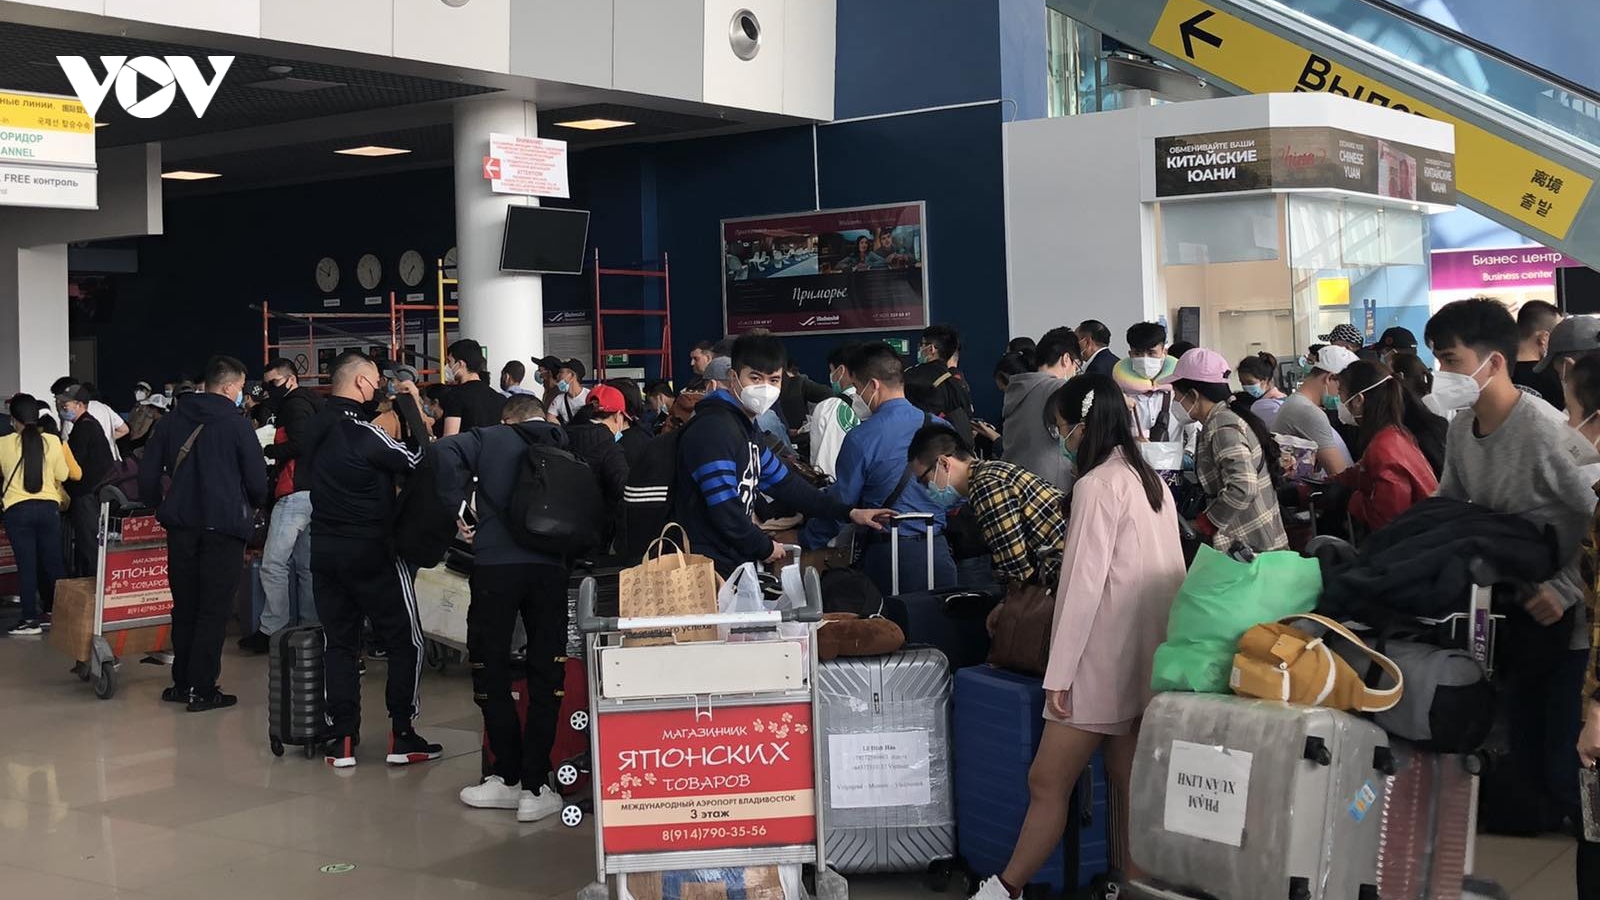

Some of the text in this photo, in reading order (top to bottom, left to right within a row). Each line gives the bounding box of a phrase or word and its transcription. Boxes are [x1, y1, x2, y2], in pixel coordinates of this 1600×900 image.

[1169, 140, 1255, 154] ОБМЕНИВАЙТЕ ВАШИ
[1166, 149, 1258, 169] КИТАЙСКИЕ
[1339, 149, 1365, 165] CHINESE
[4, 173, 79, 188] FREE контроль
[1187, 166, 1237, 182] ЮАНИ
[1531, 169, 1564, 194] 离境
[1520, 192, 1553, 218] 출발
[1472, 252, 1562, 266] Бизнес центр
[1482, 269, 1553, 282] Business center
[792, 287, 848, 306] Приморье
[112, 565, 168, 581] ЯПОНСК
[662, 726, 747, 740] МАГАЗИНЧИК
[618, 741, 790, 771] ЯПОНСКИХ
[662, 774, 751, 791] ТОВАРОВ
[1177, 772, 1203, 788] LINH
[621, 795, 796, 810] МЕЖДУНАРОДНЫЙ АЭРОПОРТ ВЛАДИВОСТОК
[690, 809, 730, 819] 3 этаж
[662, 825, 767, 842] 8(914)790-35-56
